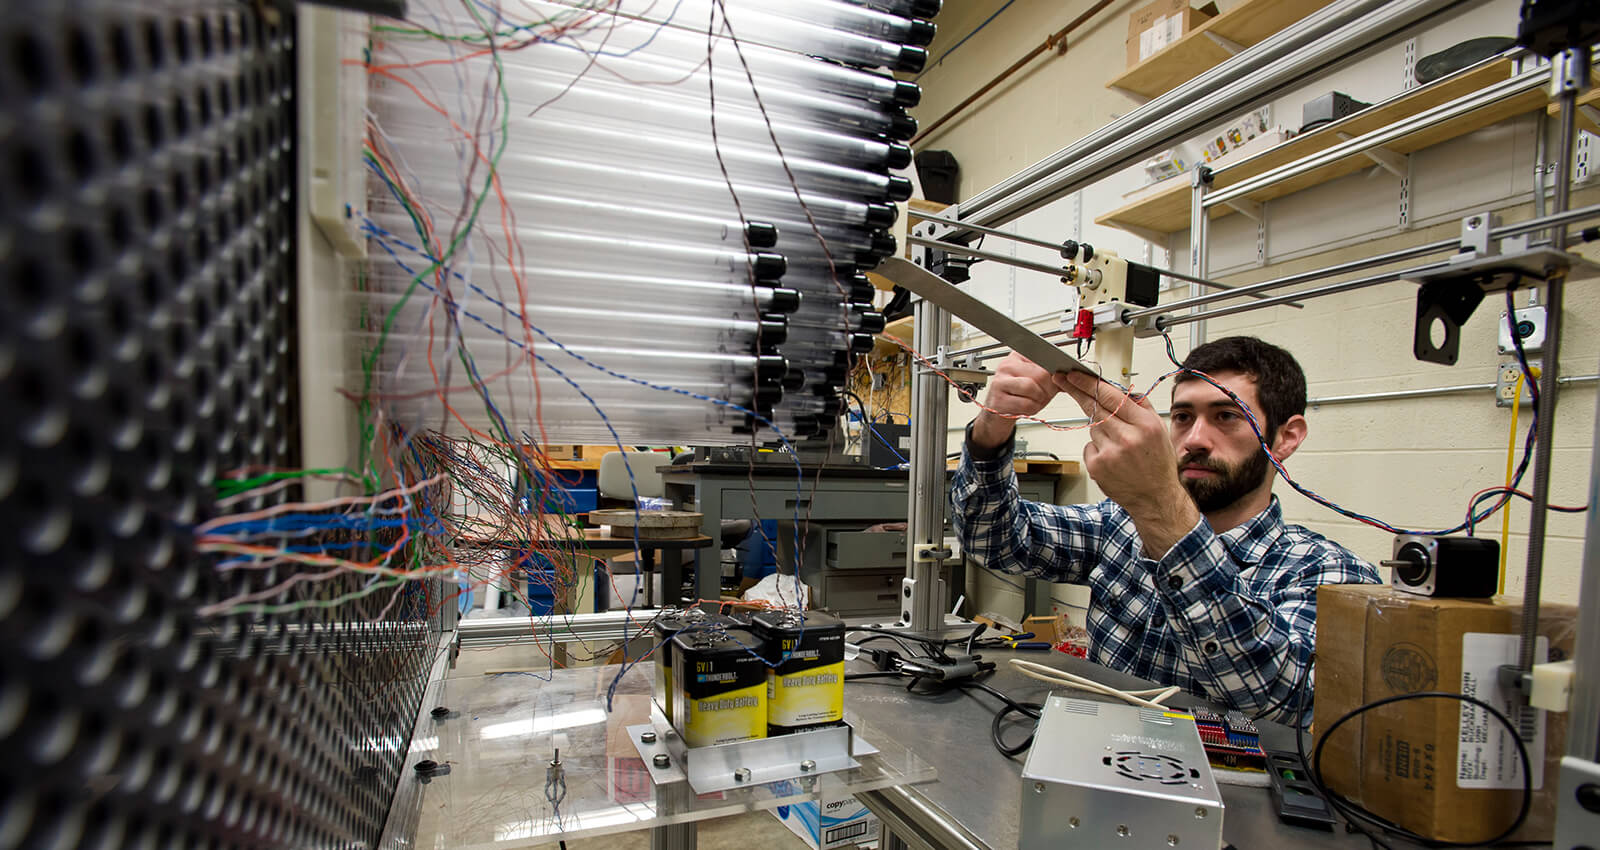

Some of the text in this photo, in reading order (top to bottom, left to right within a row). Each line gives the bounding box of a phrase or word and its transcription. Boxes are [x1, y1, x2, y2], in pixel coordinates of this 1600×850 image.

[816, 673, 838, 685] Battery
[698, 702, 719, 712] Heavy
[735, 696, 758, 708] Battery
